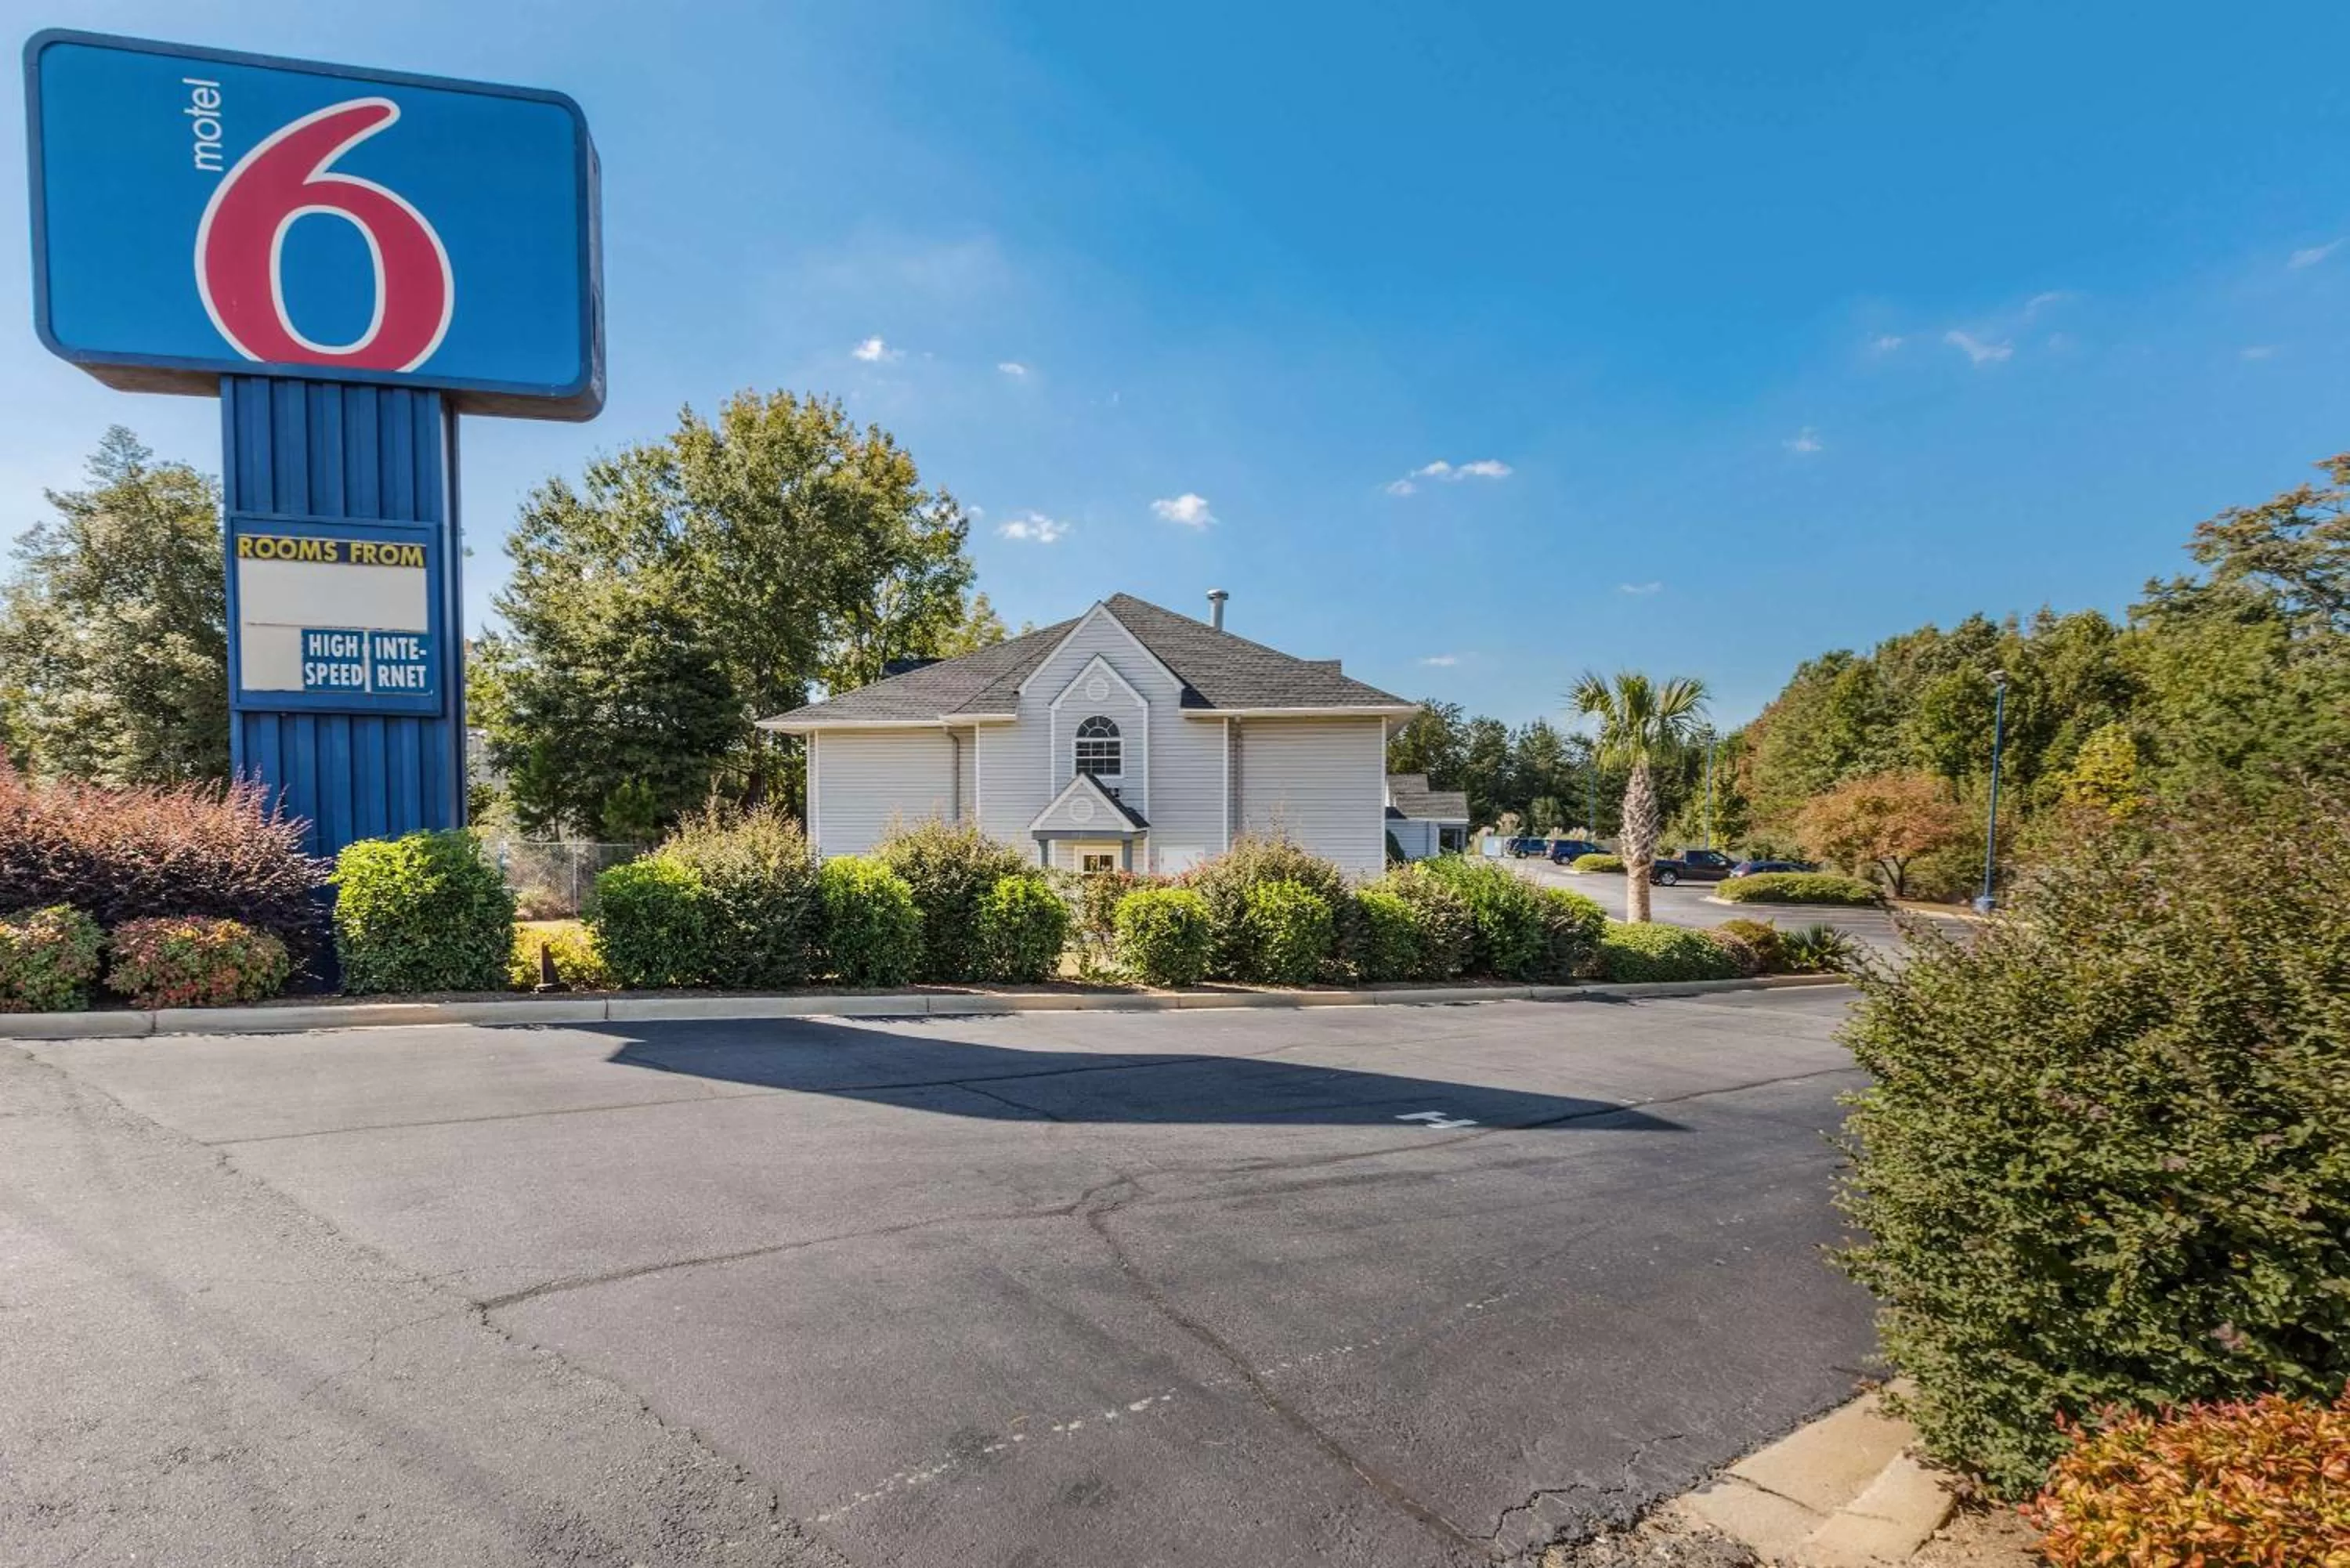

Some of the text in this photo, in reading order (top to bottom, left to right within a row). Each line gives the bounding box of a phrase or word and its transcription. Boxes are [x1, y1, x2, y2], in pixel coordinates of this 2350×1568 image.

[183, 78, 223, 172] motel
[193, 96, 455, 373] 6
[237, 537, 424, 566] ROOMS FROM
[309, 634, 358, 658] HIGH
[375, 637, 427, 660] INTE-
[306, 663, 364, 686] SPEED
[377, 665, 427, 688] RNET
